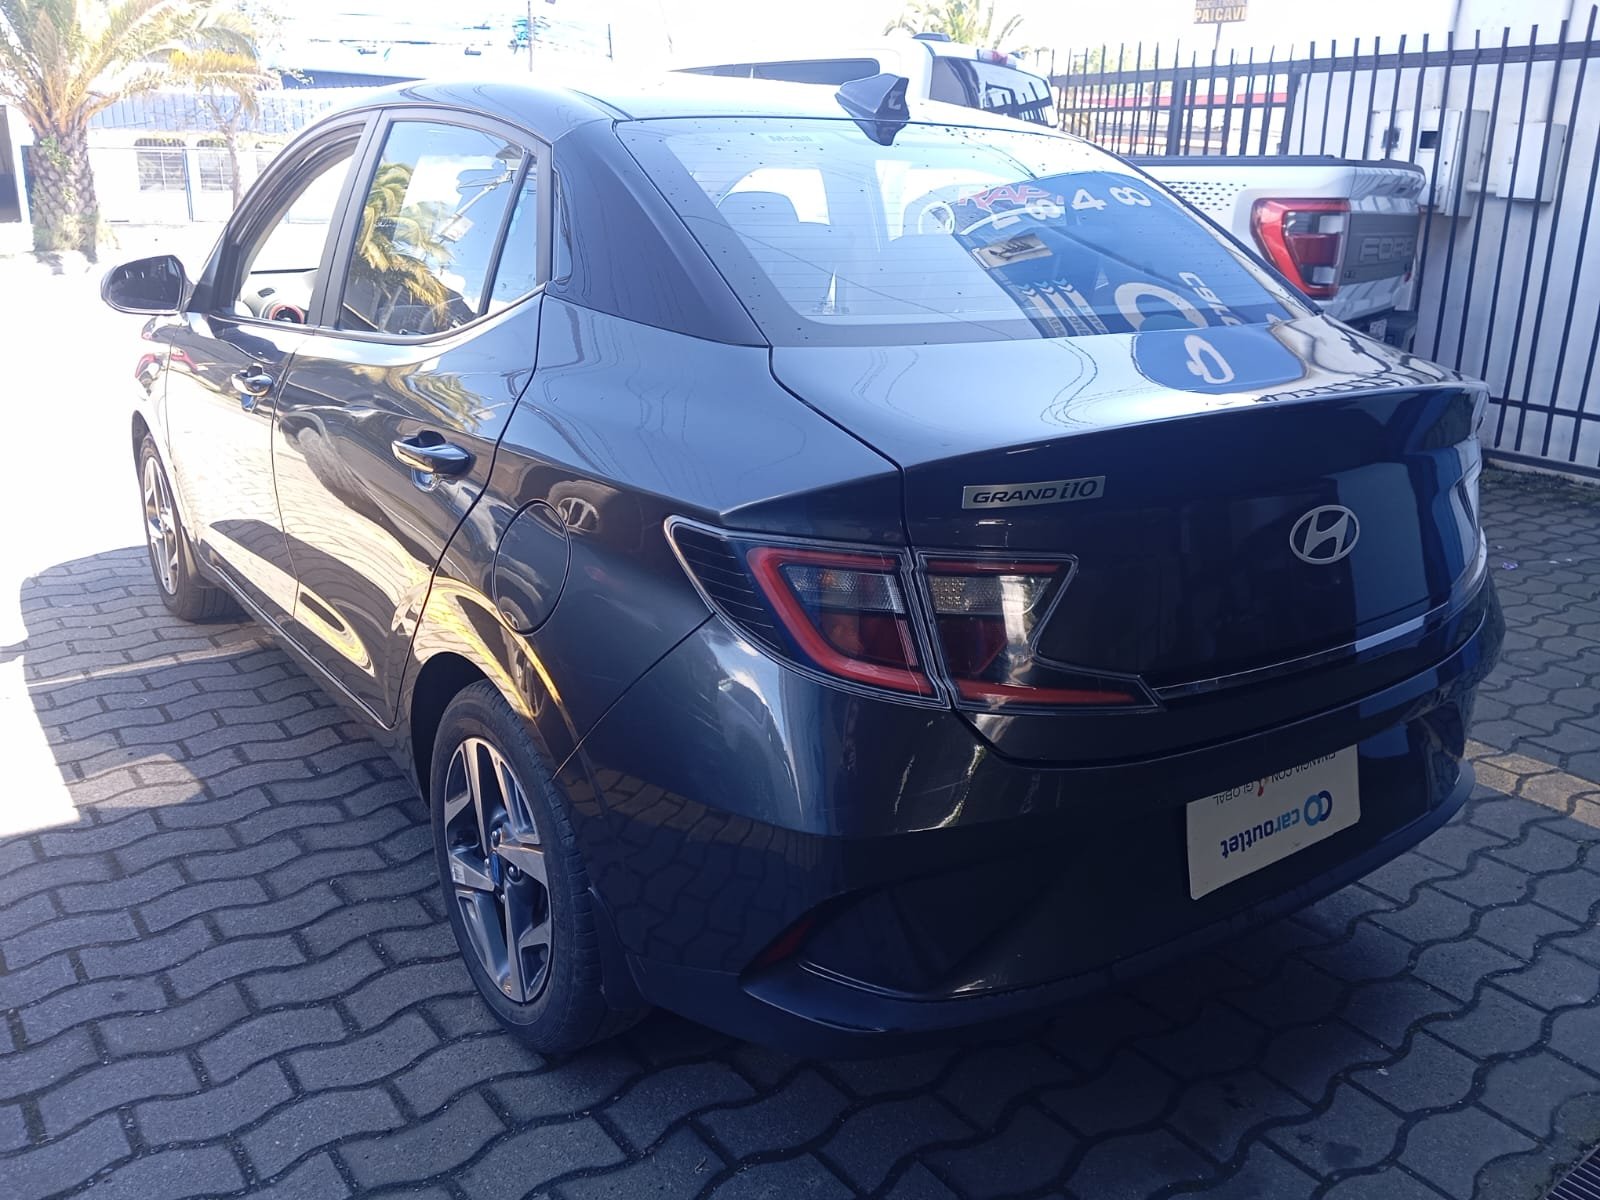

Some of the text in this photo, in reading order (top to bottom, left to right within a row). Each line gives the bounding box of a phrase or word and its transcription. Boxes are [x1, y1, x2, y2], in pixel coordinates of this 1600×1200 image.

[1359, 237, 1415, 262] FORD
[973, 480, 1098, 503] GRAND i10
[1271, 768, 1293, 783] CON
[1213, 782, 1254, 805] GLOBAL
[1220, 808, 1300, 859] caroutlet
